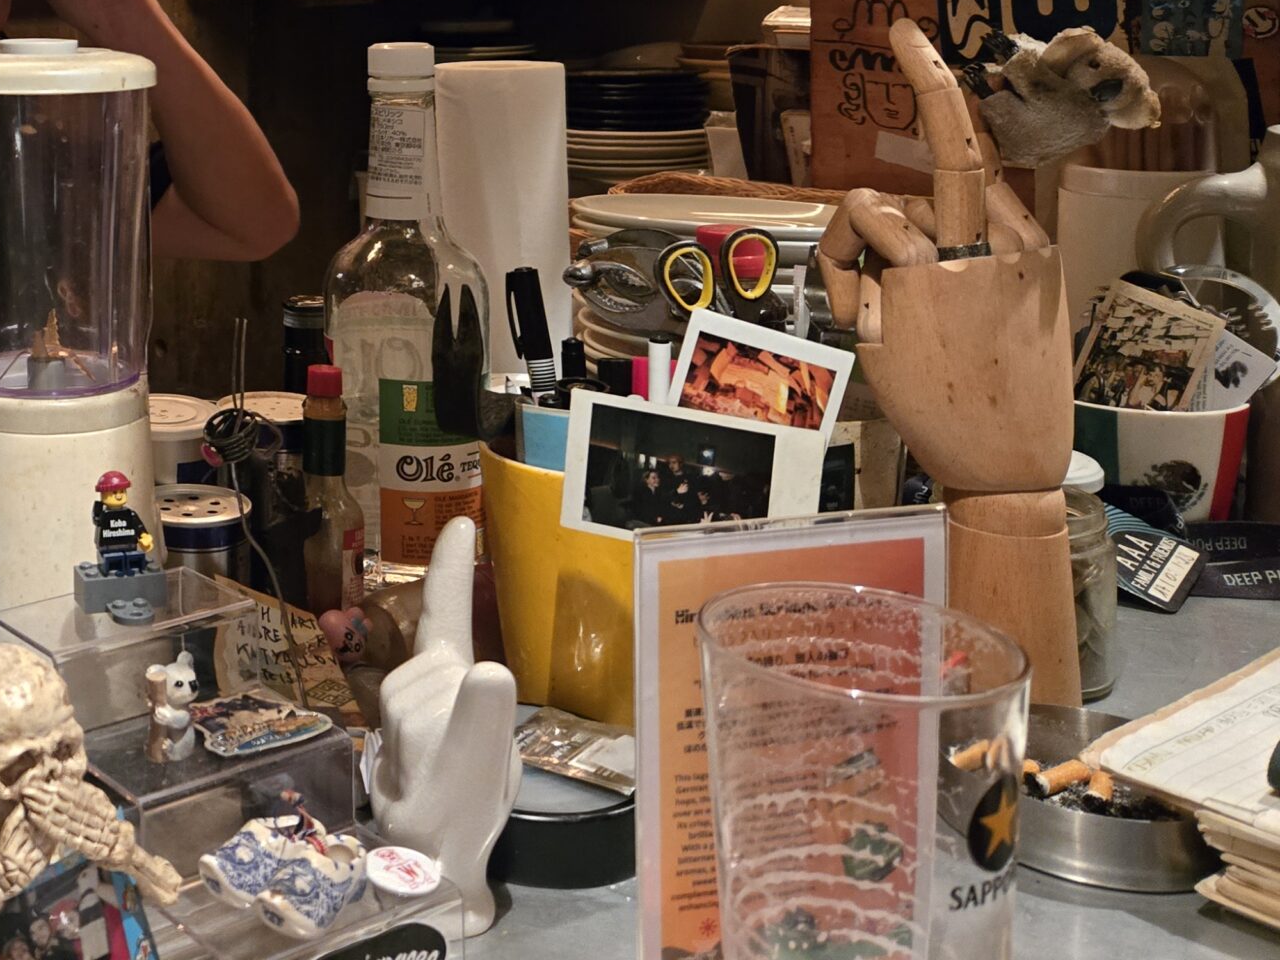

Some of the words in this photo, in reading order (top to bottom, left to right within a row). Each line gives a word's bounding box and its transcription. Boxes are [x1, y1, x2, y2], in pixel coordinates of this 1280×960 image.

[396, 453, 455, 483] Olé
[1116, 534, 1154, 572] AAA
[1224, 571, 1263, 587] DEEP
